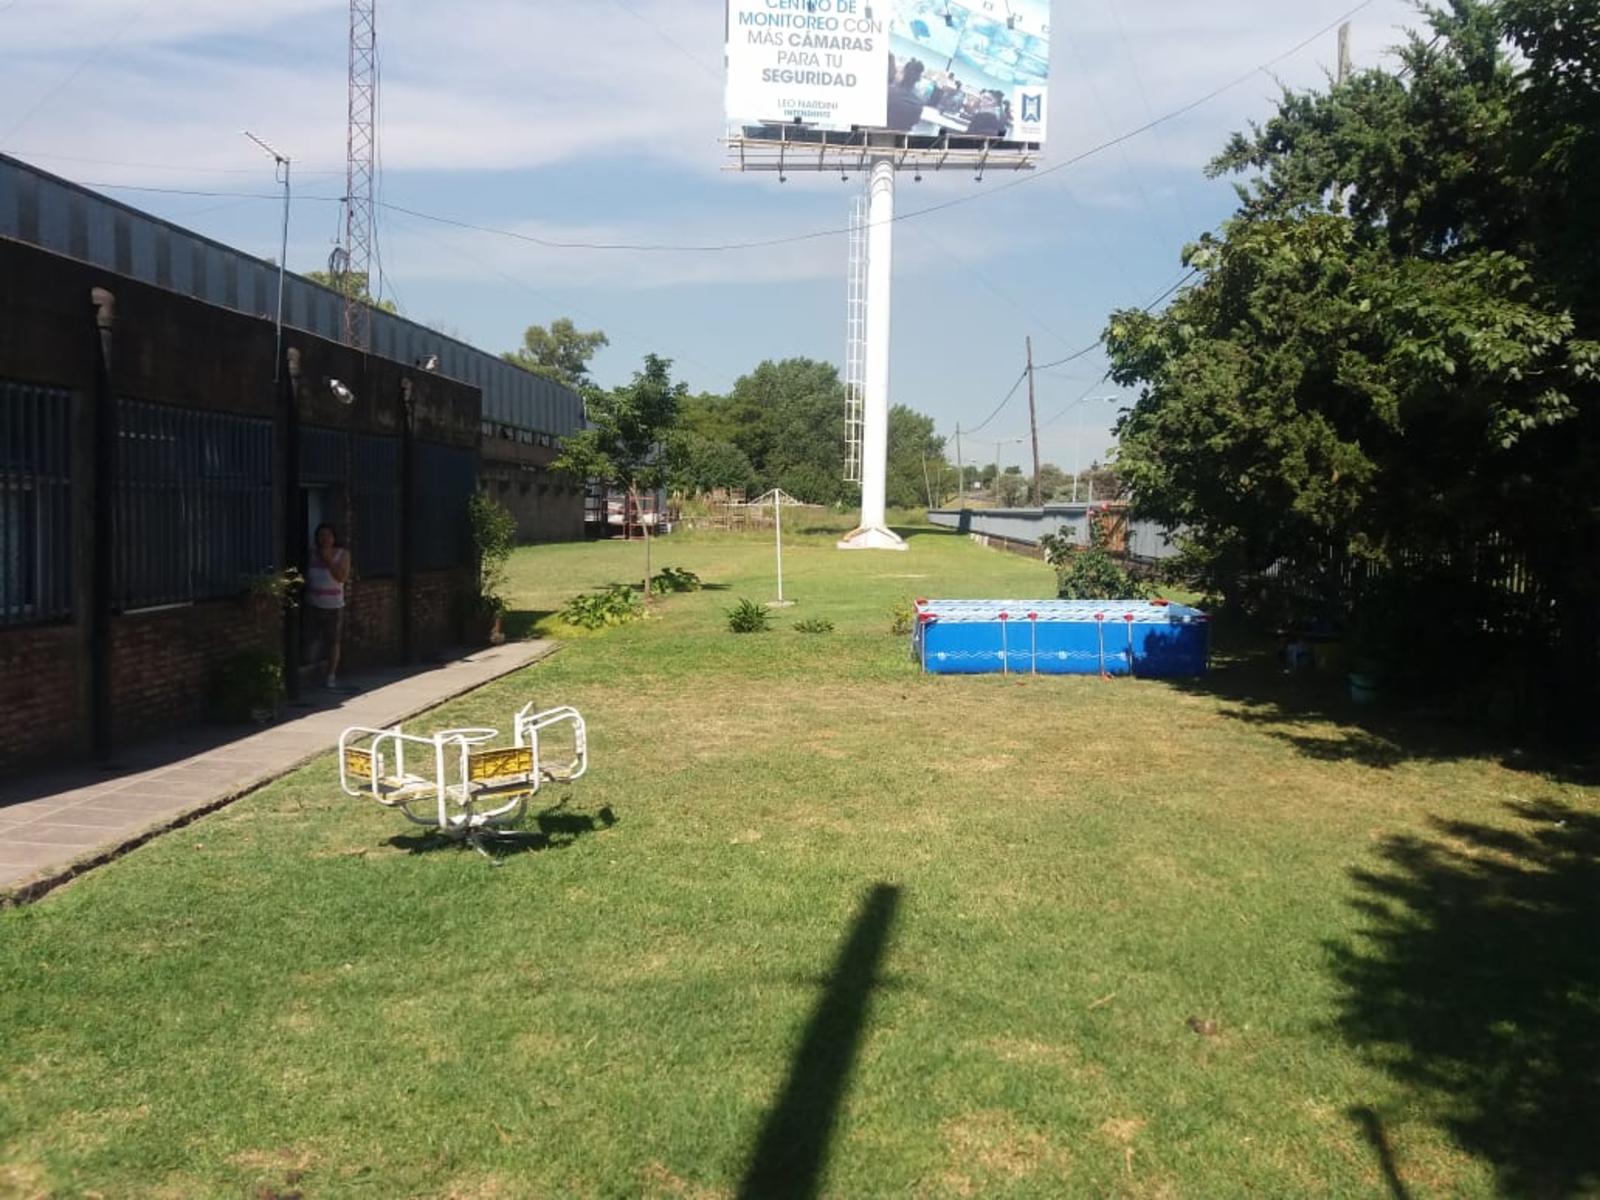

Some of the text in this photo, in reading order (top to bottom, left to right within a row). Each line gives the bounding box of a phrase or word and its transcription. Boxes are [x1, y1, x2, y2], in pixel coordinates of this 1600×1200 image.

[836, 0, 857, 14] DE
[738, 11, 883, 34] MONITOREO CON
[747, 29, 874, 52] MÁS CÁMARAS
[777, 50, 843, 68] PARA TU
[762, 68, 857, 88] SEGURIDAD
[777, 98, 797, 109] LEO
